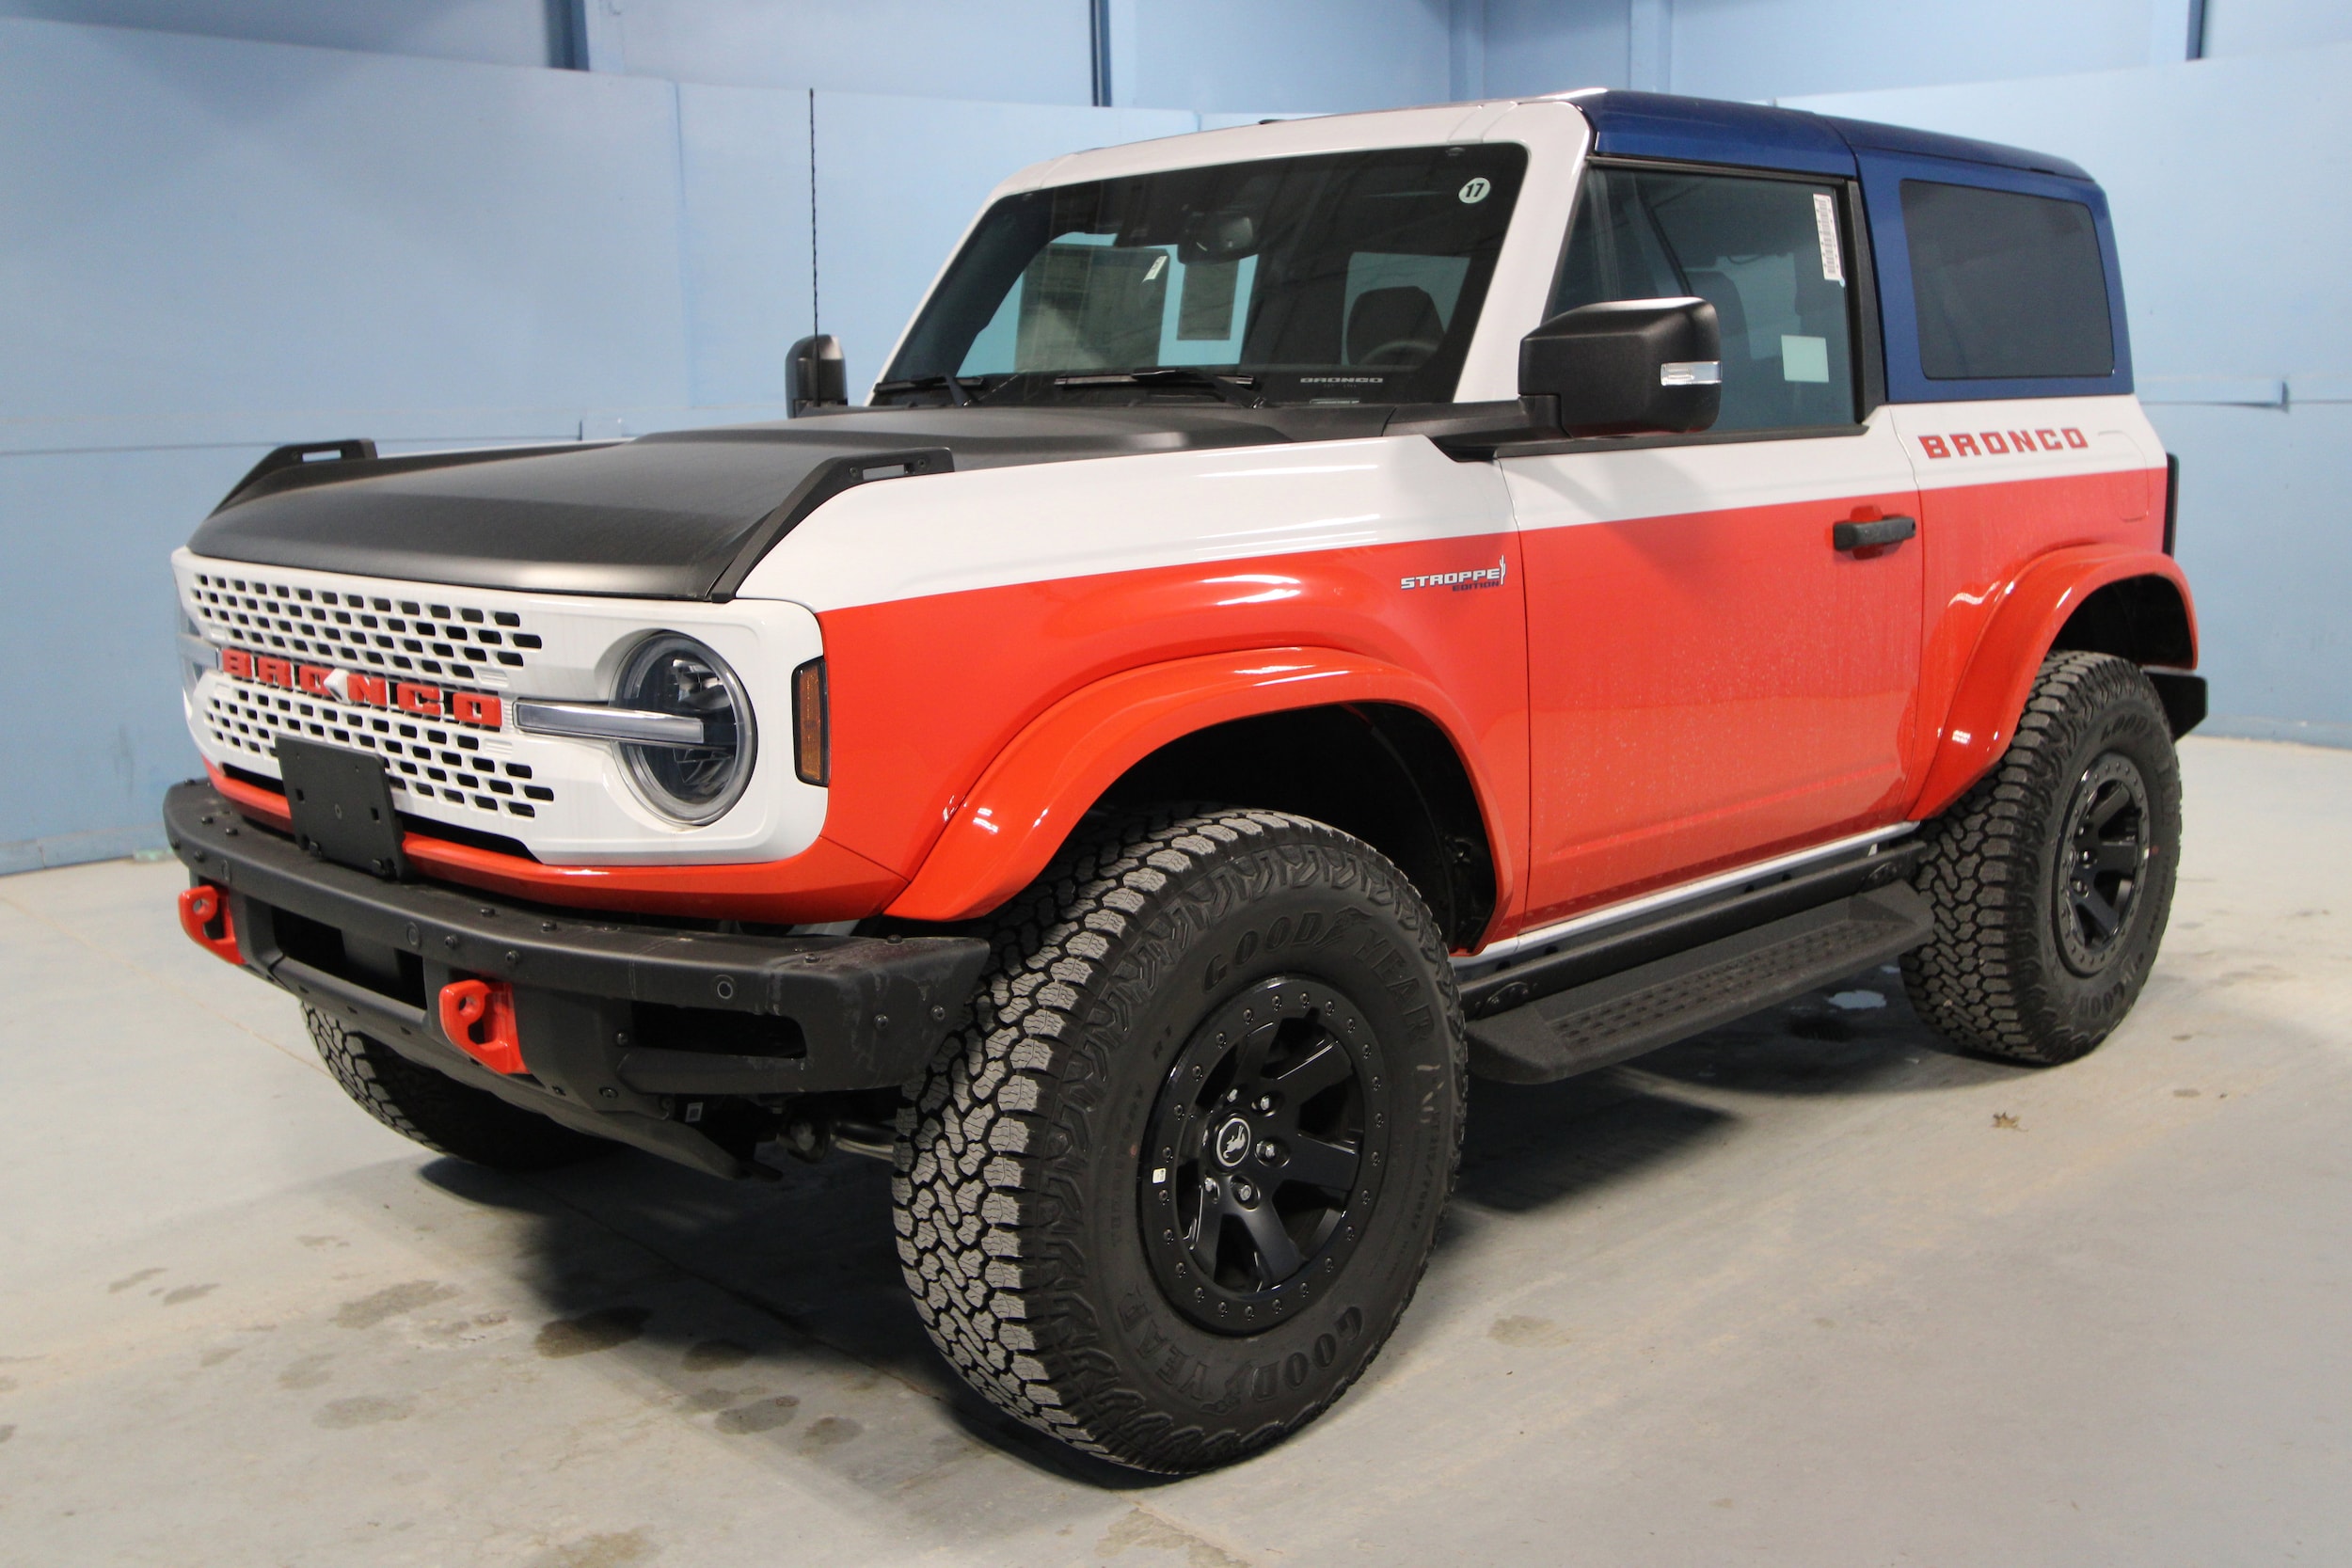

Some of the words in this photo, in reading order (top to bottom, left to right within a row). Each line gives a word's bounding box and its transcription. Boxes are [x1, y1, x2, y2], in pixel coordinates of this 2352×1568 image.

[1463, 182, 1486, 198] 17
[1917, 427, 2090, 459] BRONCO
[1400, 567, 1501, 590] STROPPE
[1452, 580, 1500, 592] EDITION
[222, 648, 502, 727] BRONCO
